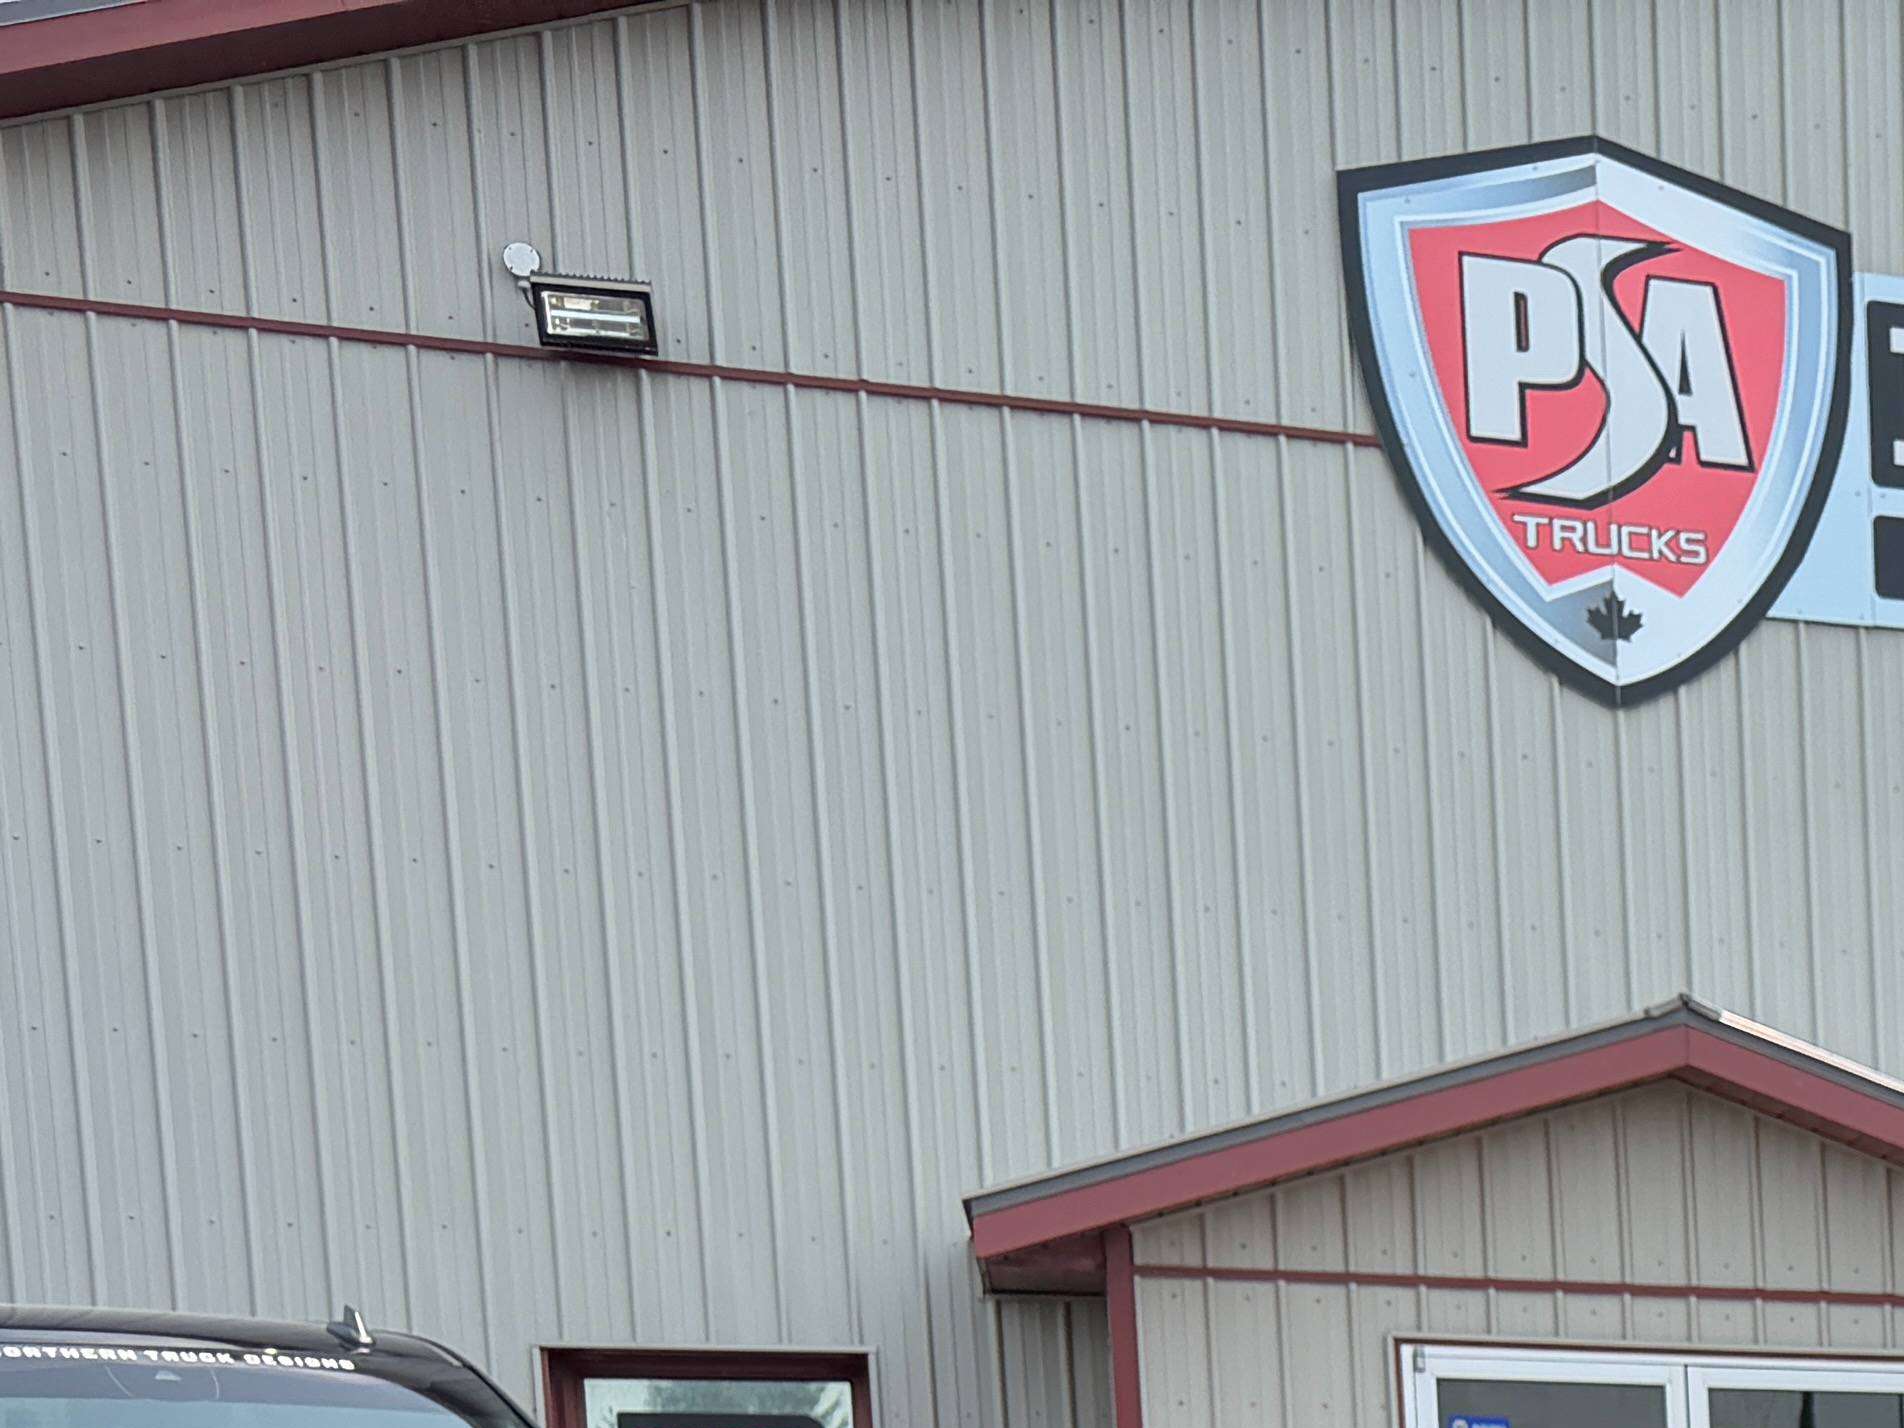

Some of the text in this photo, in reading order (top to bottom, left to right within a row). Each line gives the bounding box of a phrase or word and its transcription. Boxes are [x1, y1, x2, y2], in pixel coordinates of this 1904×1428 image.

[1458, 231, 1755, 509] PSA
[1512, 514, 1710, 566] TRUCKS
[0, 1346, 138, 1361] ORTHERN
[142, 1349, 236, 1364] TRUCK
